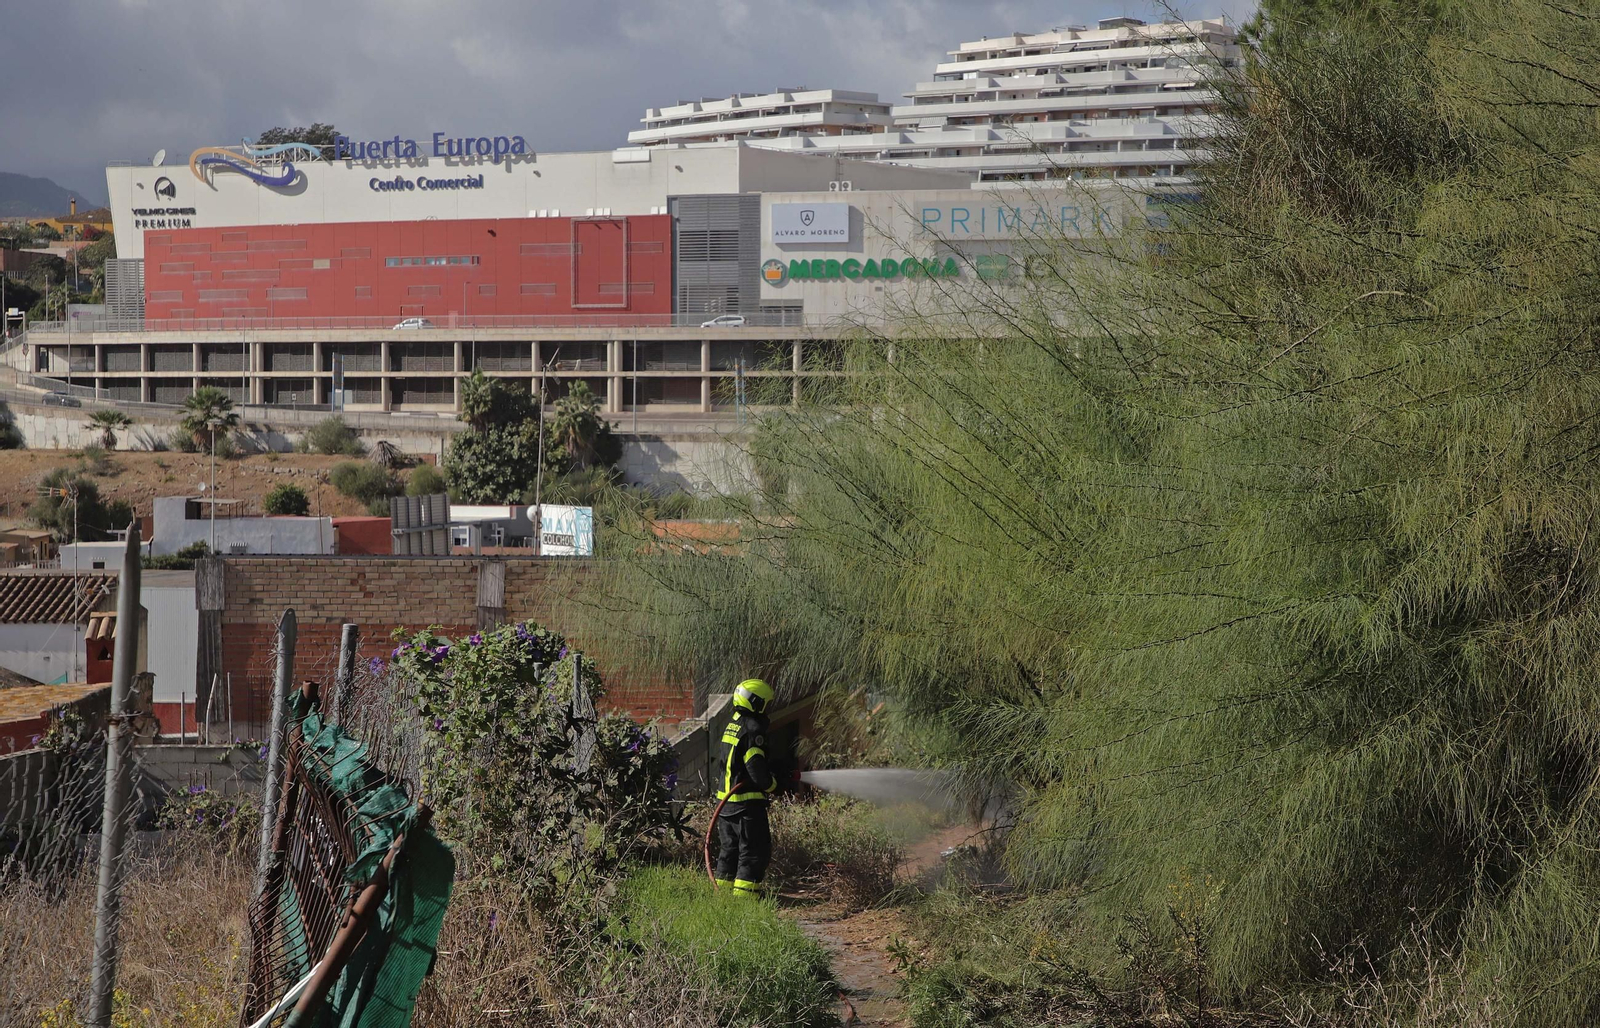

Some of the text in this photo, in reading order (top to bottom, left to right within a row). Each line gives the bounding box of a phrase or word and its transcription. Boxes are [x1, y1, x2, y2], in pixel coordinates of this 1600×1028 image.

[334, 132, 525, 163] Puerta Europa
[369, 174, 483, 191] Centro Comercial
[131, 207, 196, 216] YELMO CINES
[922, 206, 1114, 234] PRIMARK
[135, 219, 191, 229] PREMIUM
[787, 257, 959, 279] MERCADONA
